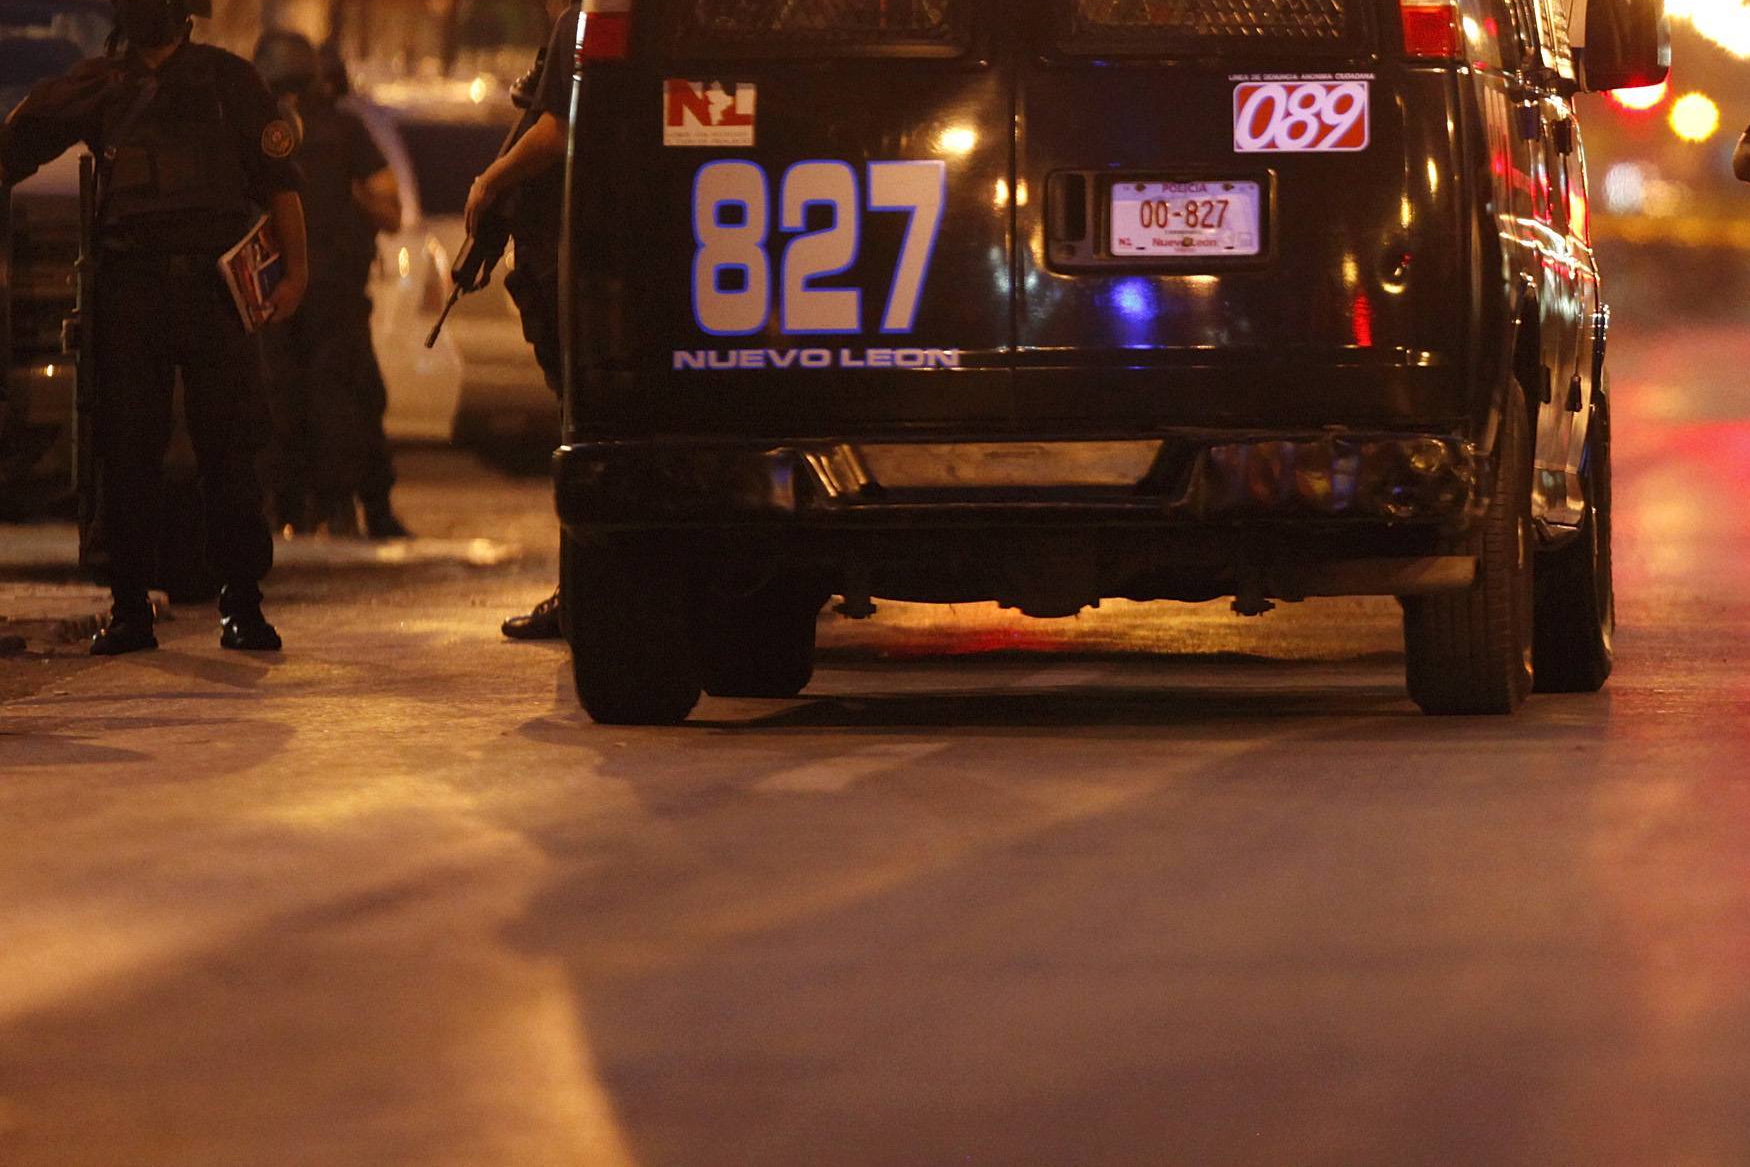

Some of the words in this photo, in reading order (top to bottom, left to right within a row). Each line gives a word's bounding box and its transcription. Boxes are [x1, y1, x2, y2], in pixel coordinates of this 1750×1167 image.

[1236, 82, 1366, 150] 089
[1162, 182, 1208, 194] POLICIA
[1140, 199, 1230, 229] 00-827
[691, 159, 946, 335] 827
[672, 348, 832, 370] NUEVO
[839, 347, 961, 368] LEON
